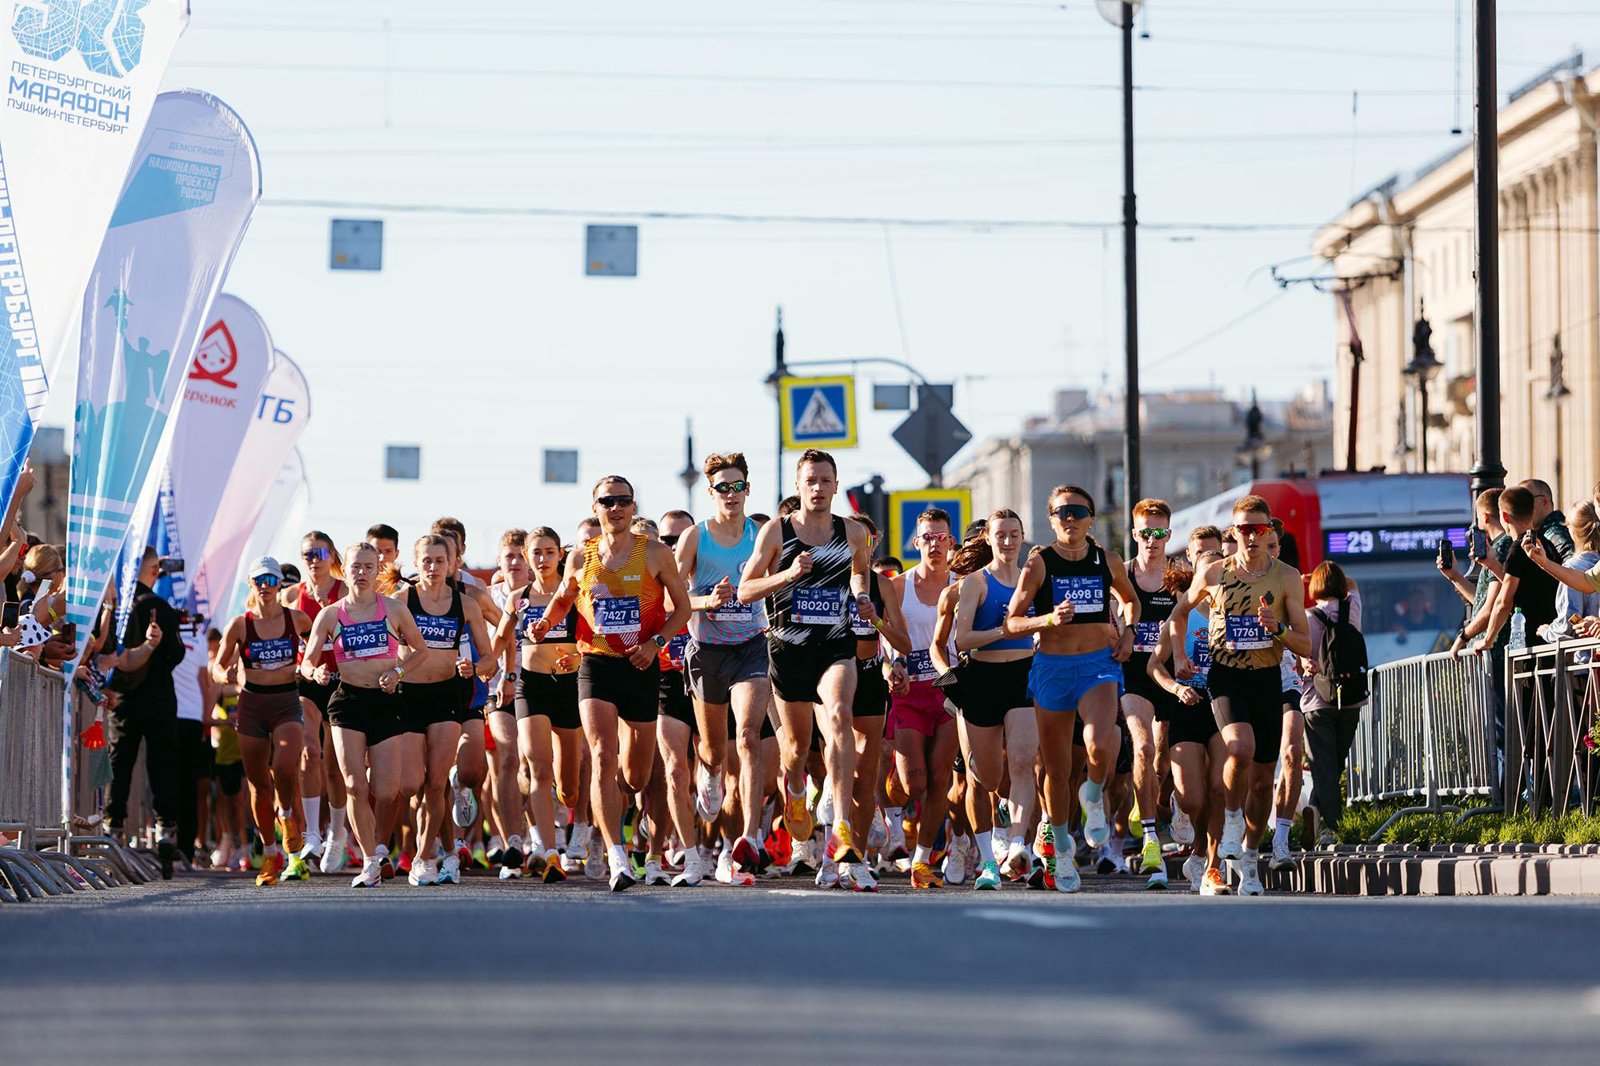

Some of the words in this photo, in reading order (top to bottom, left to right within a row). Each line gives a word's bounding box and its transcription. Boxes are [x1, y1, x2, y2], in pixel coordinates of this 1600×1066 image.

[11, 60, 131, 101] ПЕТЕРБУРГСКИЙ
[8, 75, 130, 123] МАРАФОН
[7, 98, 128, 135] ПУШКИН-ПЕТЕРБУРГ
[168, 141, 224, 157] ДЕМОГРАФИЯ
[148, 156, 219, 179] НАЦИОНАЛЬНЫЕ
[176, 173, 216, 190] ПРОЕКТЫ
[181, 187, 213, 202] РОССИИ
[1347, 531, 1373, 553] 29
[1065, 590, 1091, 599] 6698
[797, 601, 830, 610] 18020
[603, 611, 626, 620] 7427
[347, 634, 375, 646] 17993
[1233, 628, 1258, 637] 17761
[259, 650, 282, 660] 4334
